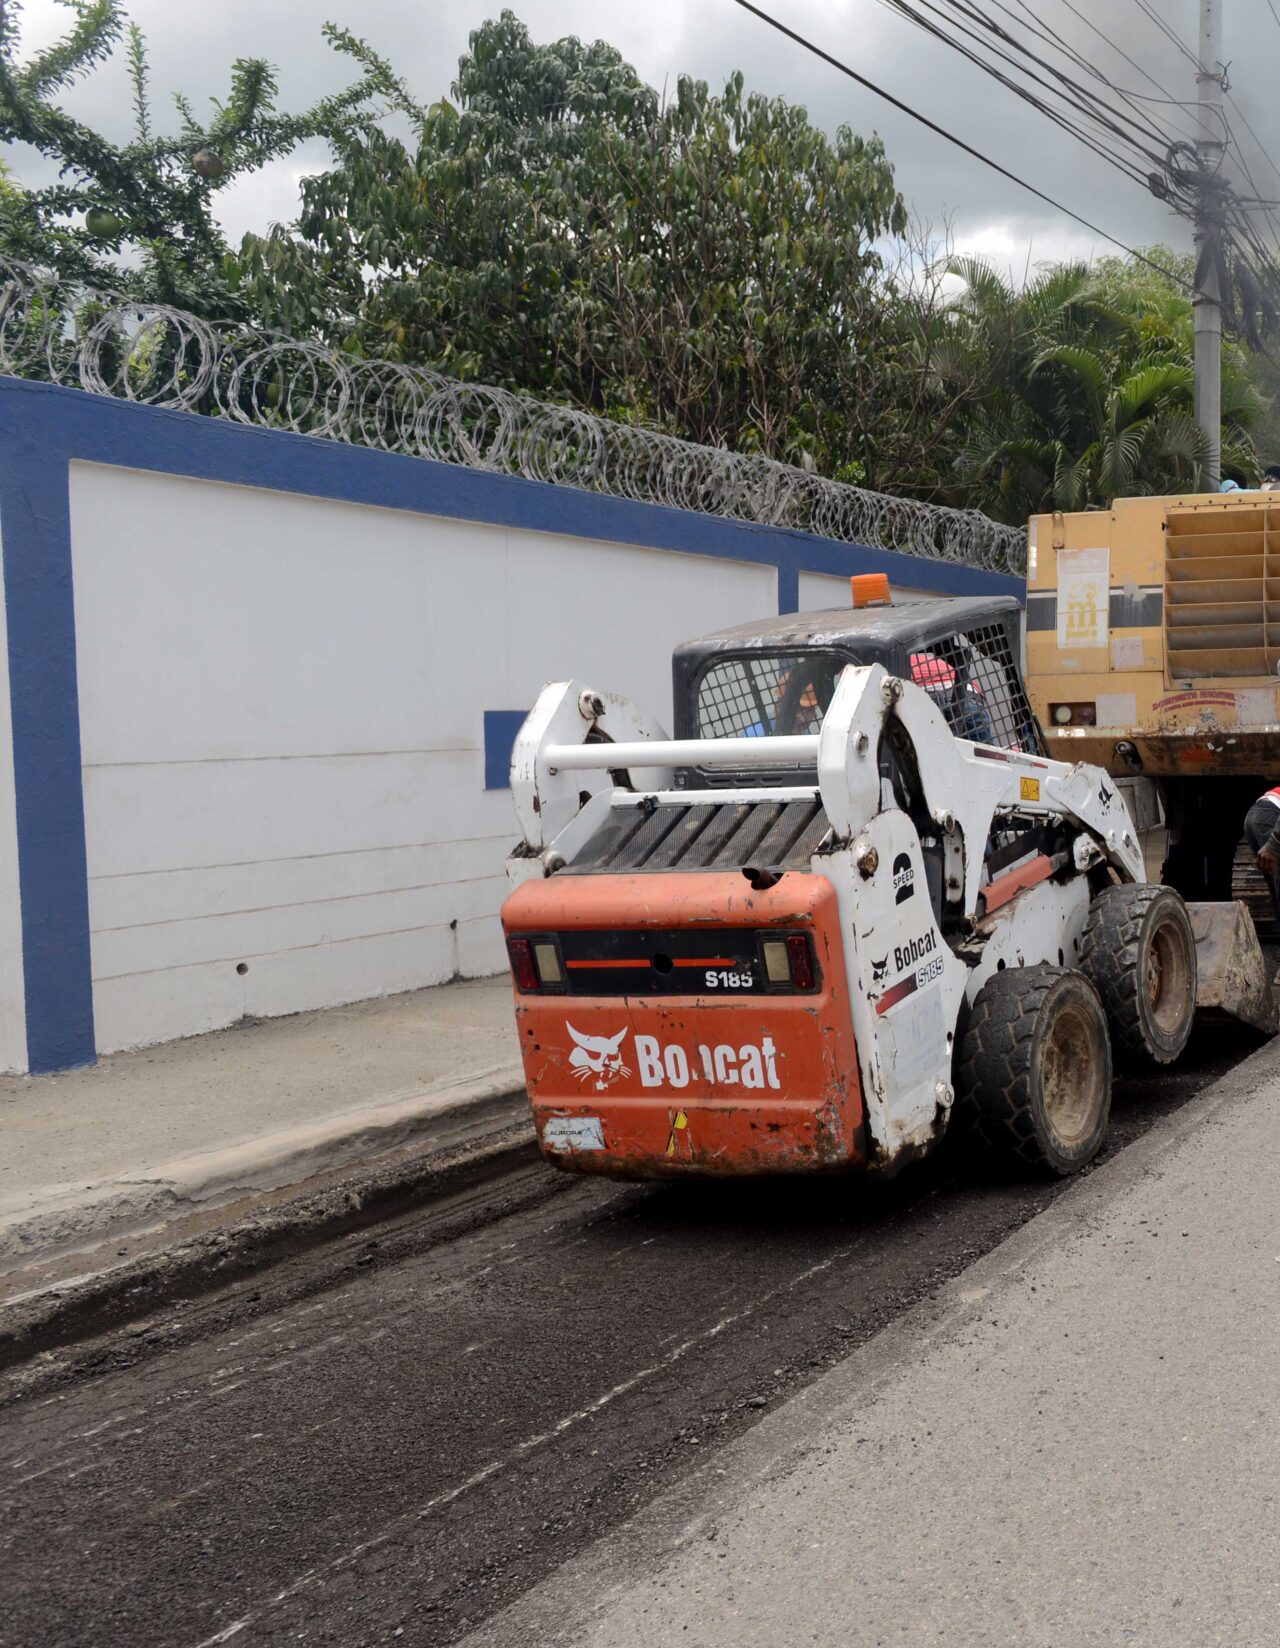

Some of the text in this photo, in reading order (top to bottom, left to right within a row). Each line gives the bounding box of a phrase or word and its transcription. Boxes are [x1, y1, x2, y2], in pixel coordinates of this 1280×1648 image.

[893, 869, 915, 889] SPEED
[893, 926, 937, 973] Bobcat
[705, 970, 753, 988] S185
[918, 954, 945, 988] S185
